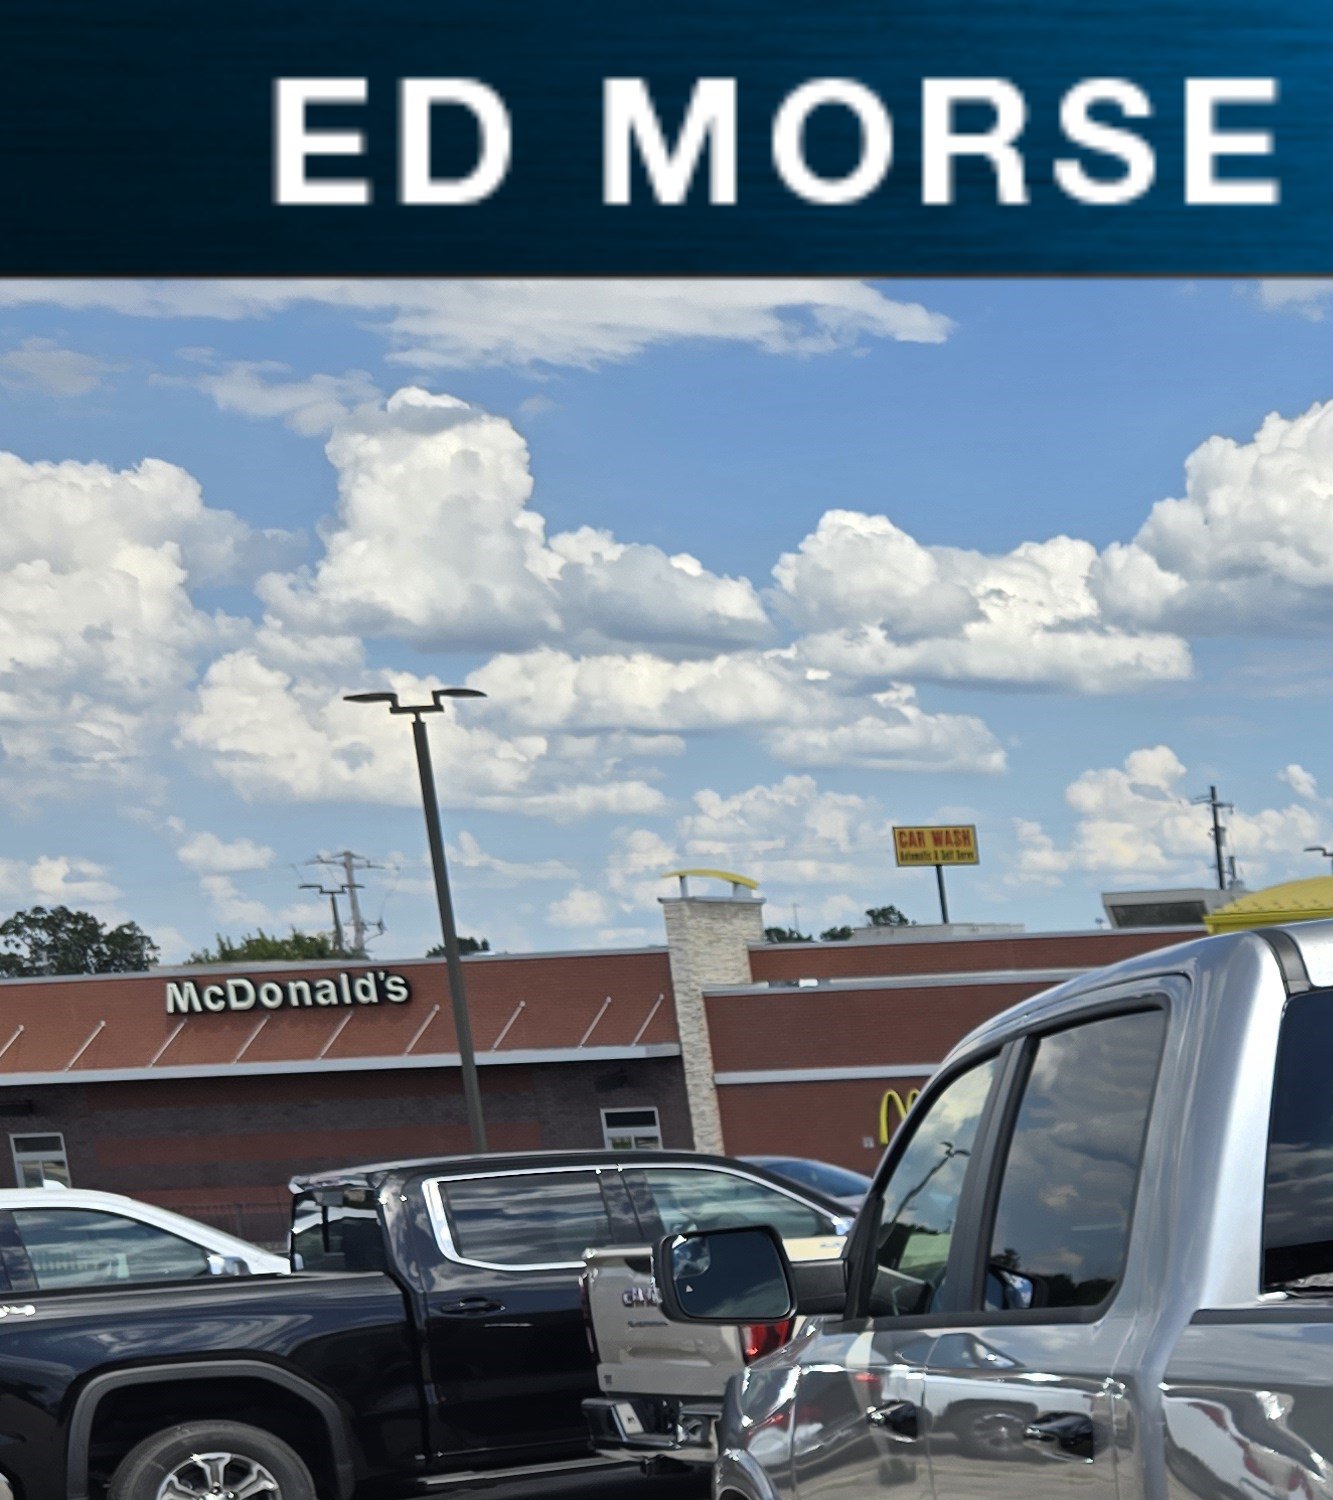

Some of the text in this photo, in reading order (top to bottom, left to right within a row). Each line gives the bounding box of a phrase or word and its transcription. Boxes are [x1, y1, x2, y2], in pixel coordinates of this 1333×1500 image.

[898, 830, 971, 848] CAR WASH
[165, 971, 410, 1014] McDonald's
